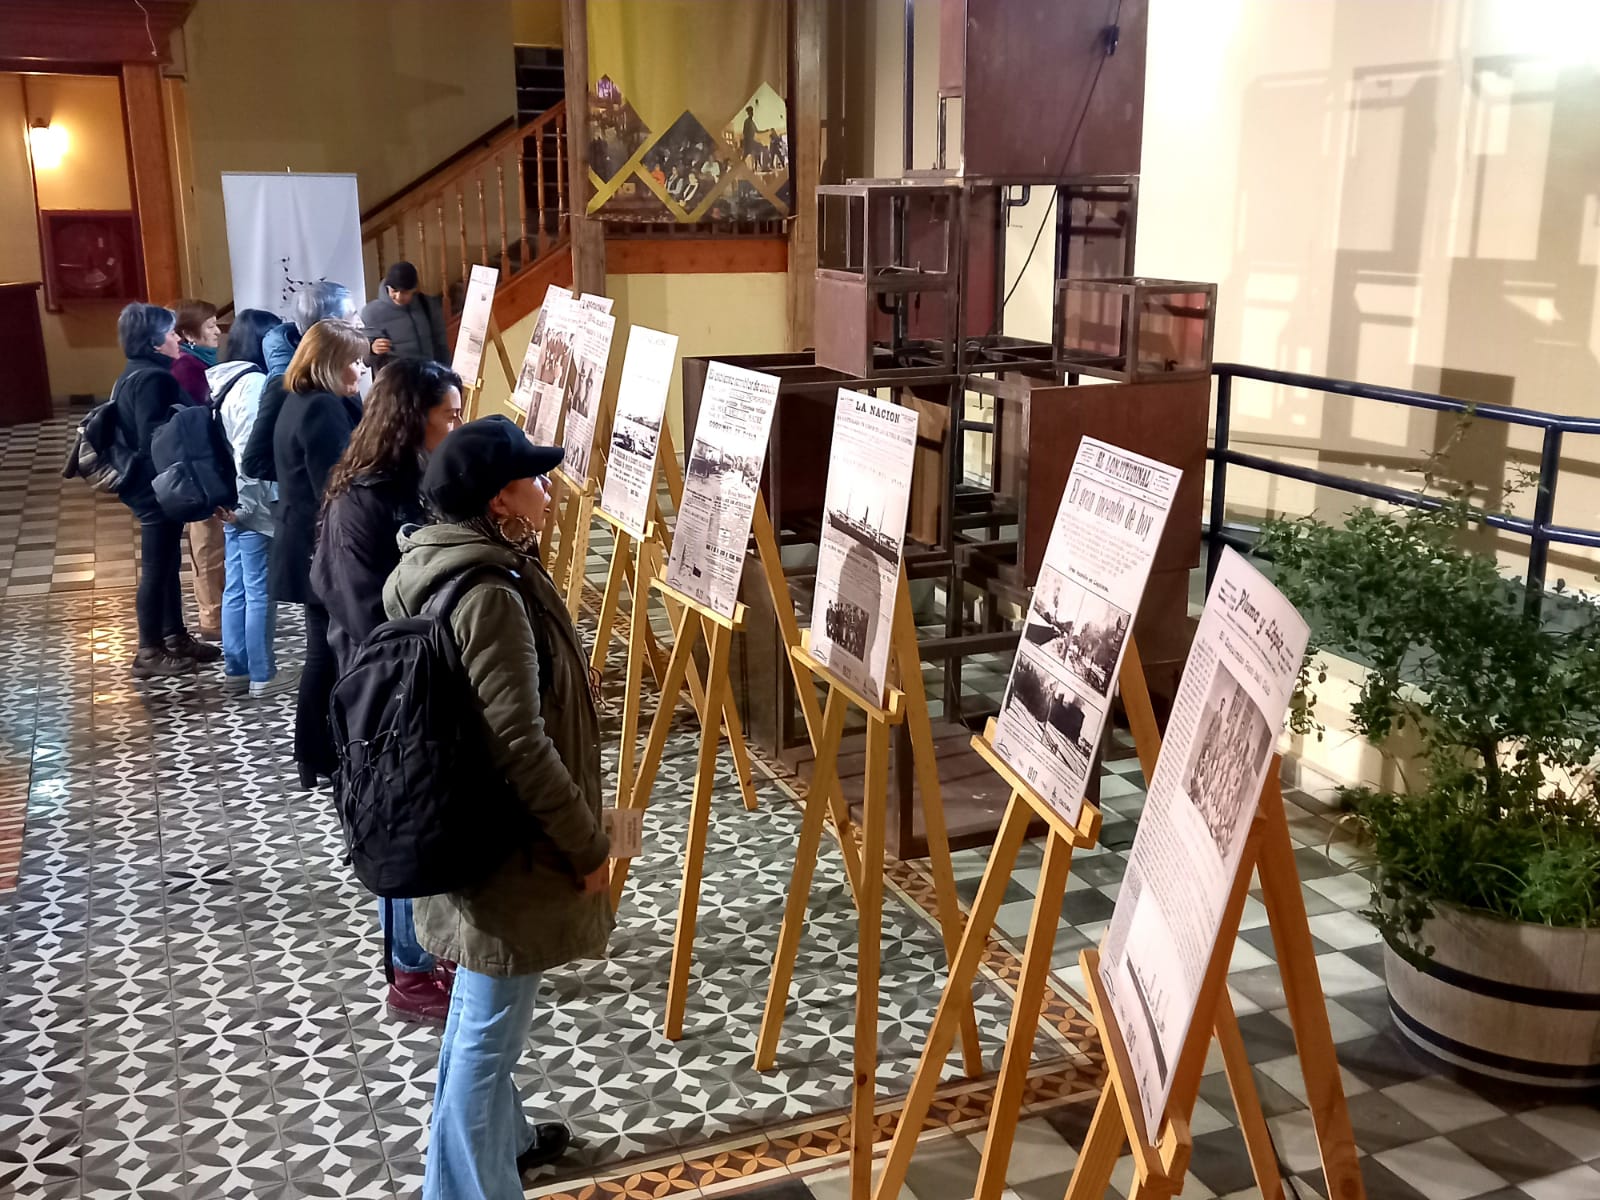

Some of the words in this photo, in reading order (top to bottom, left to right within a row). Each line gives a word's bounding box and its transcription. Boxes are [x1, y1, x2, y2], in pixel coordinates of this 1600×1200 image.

[856, 401, 866, 412] LA
[870, 405, 900, 423] NACION
[1068, 478, 1081, 504] El
[1079, 488, 1096, 511] gran
[1124, 502, 1136, 531] de
[1135, 505, 1154, 542] hoy
[1234, 588, 1260, 623] Pluma
[1256, 617, 1266, 635] y
